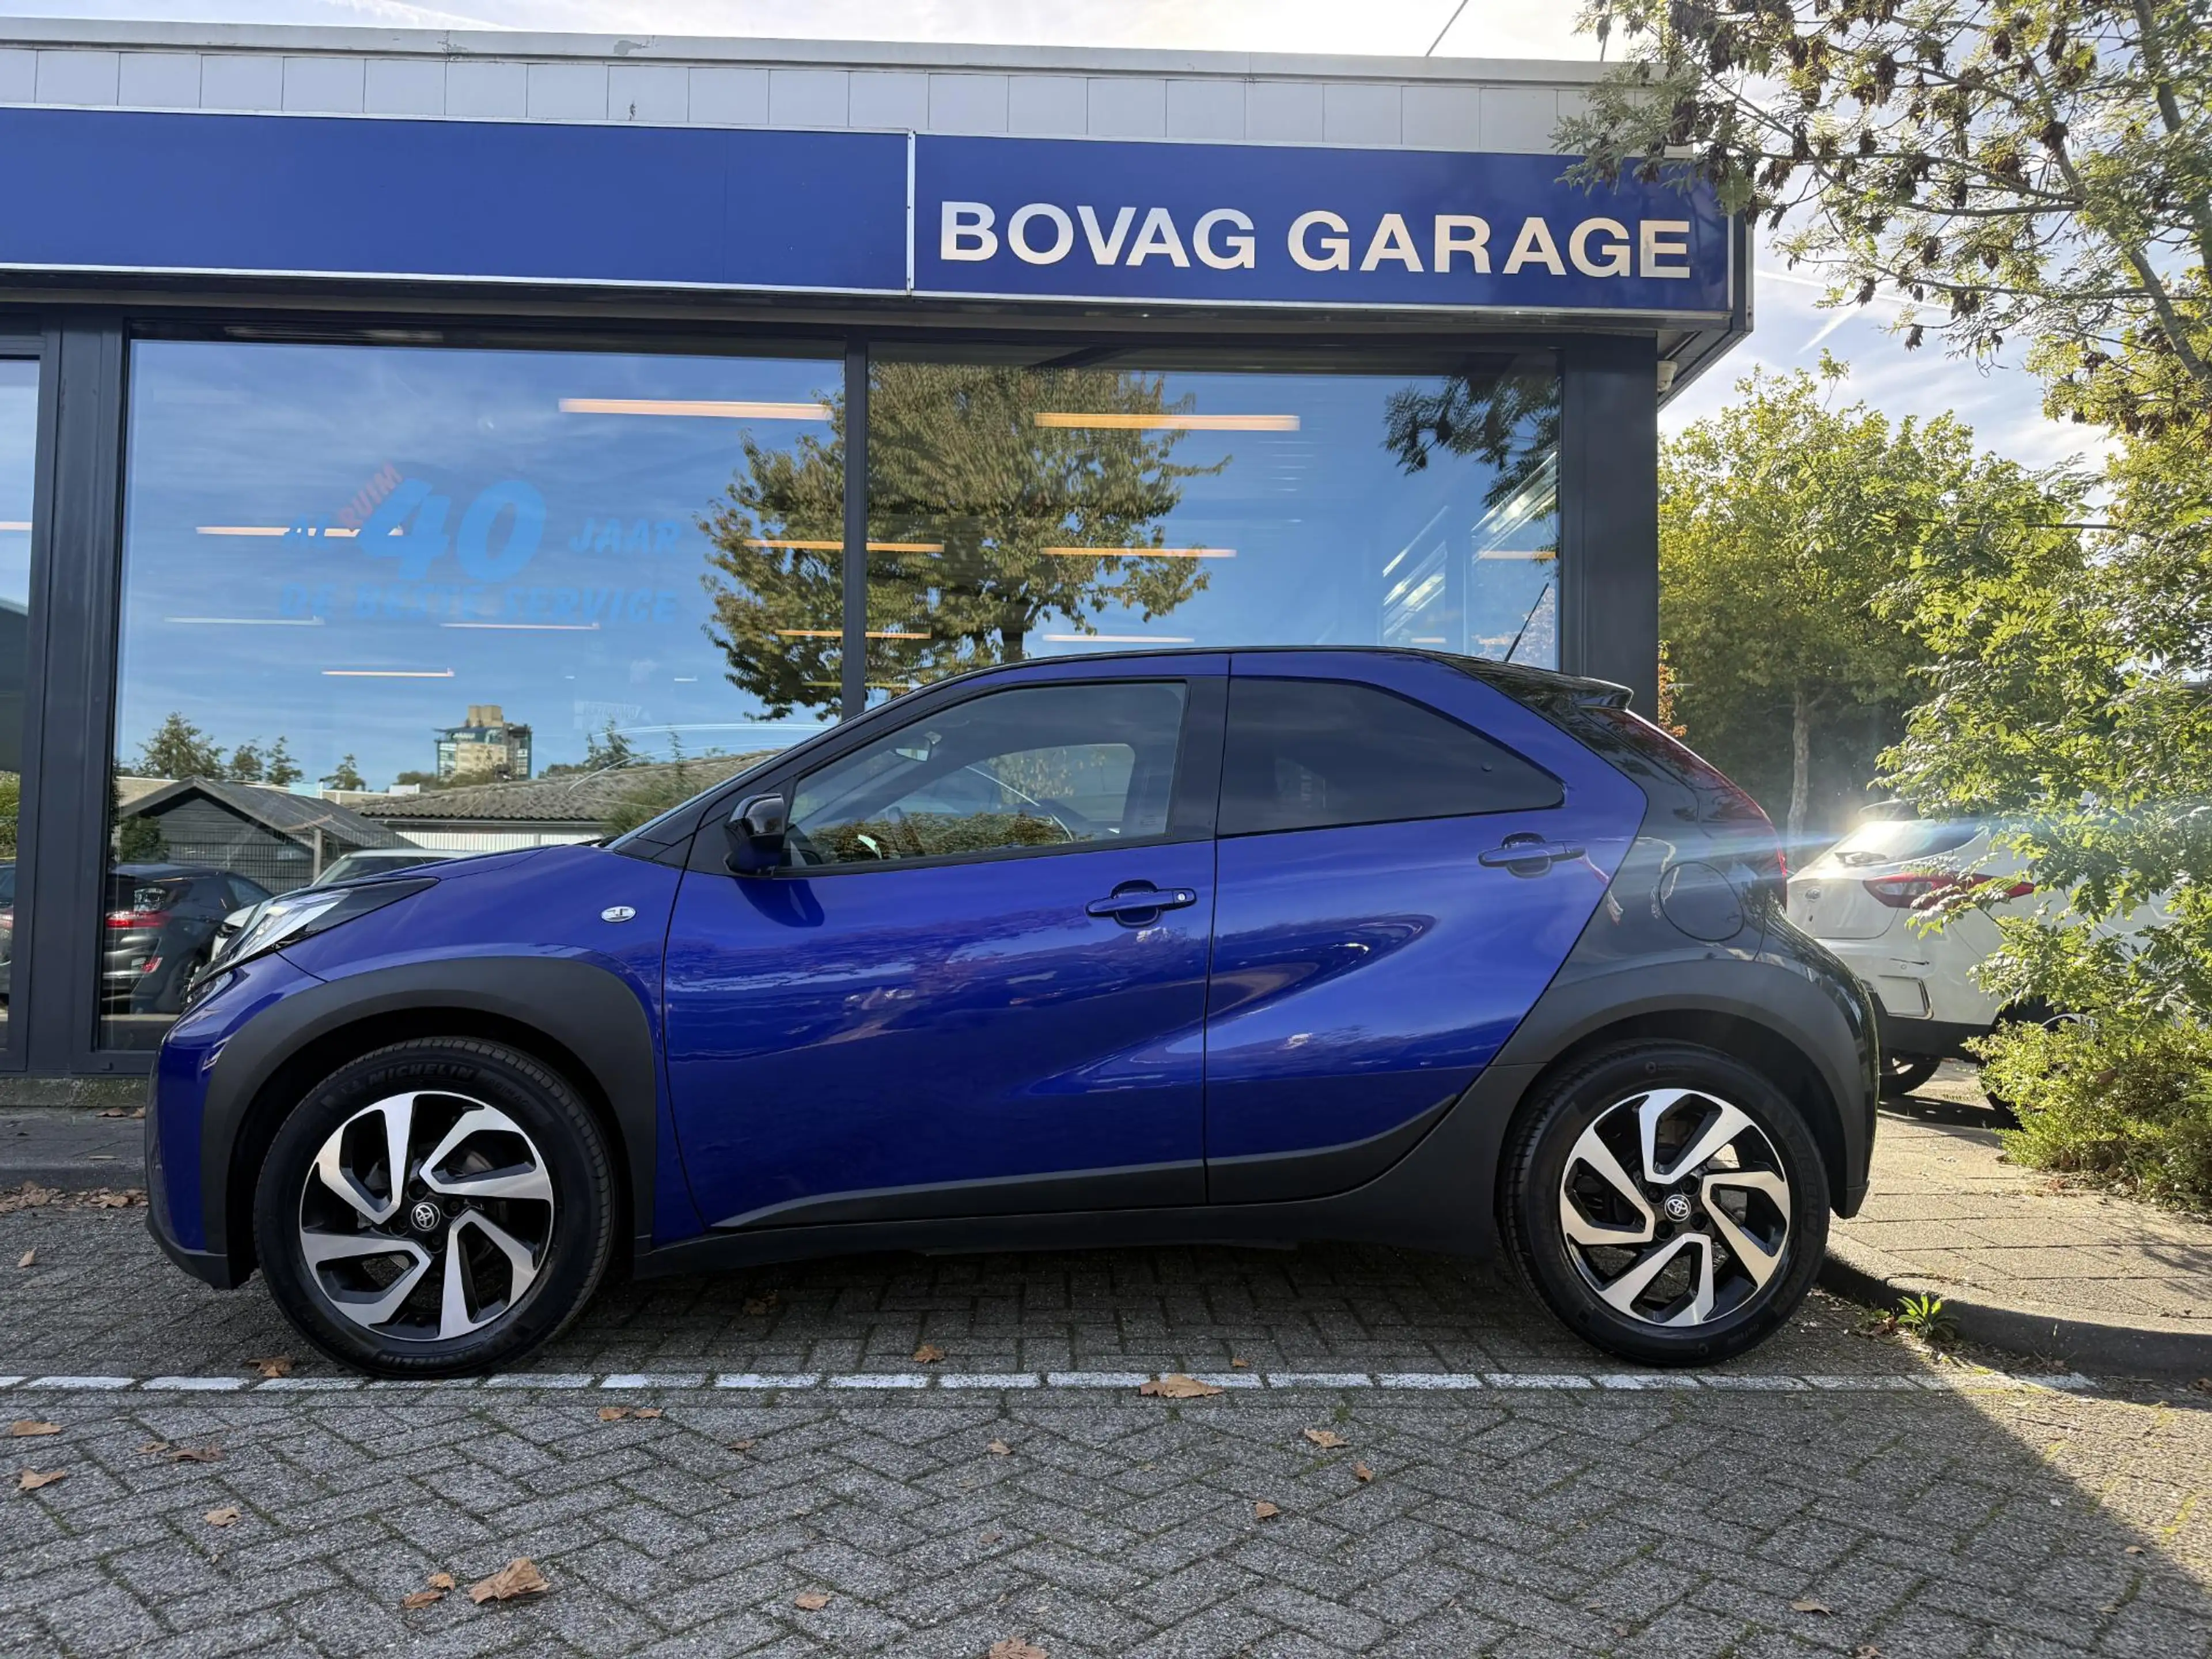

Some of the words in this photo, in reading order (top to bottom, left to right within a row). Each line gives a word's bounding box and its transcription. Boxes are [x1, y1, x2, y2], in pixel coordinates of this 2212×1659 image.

[941, 202, 1256, 269] BOVAG
[1287, 210, 1691, 279] GARAGE
[338, 460, 403, 531] RUIM
[357, 479, 547, 582] 40
[569, 518, 681, 554] JAAR
[280, 583, 336, 617] DE
[356, 584, 487, 620] BESTE
[503, 587, 677, 622] SERVICE
[369, 1063, 474, 1085] MICHELIN
